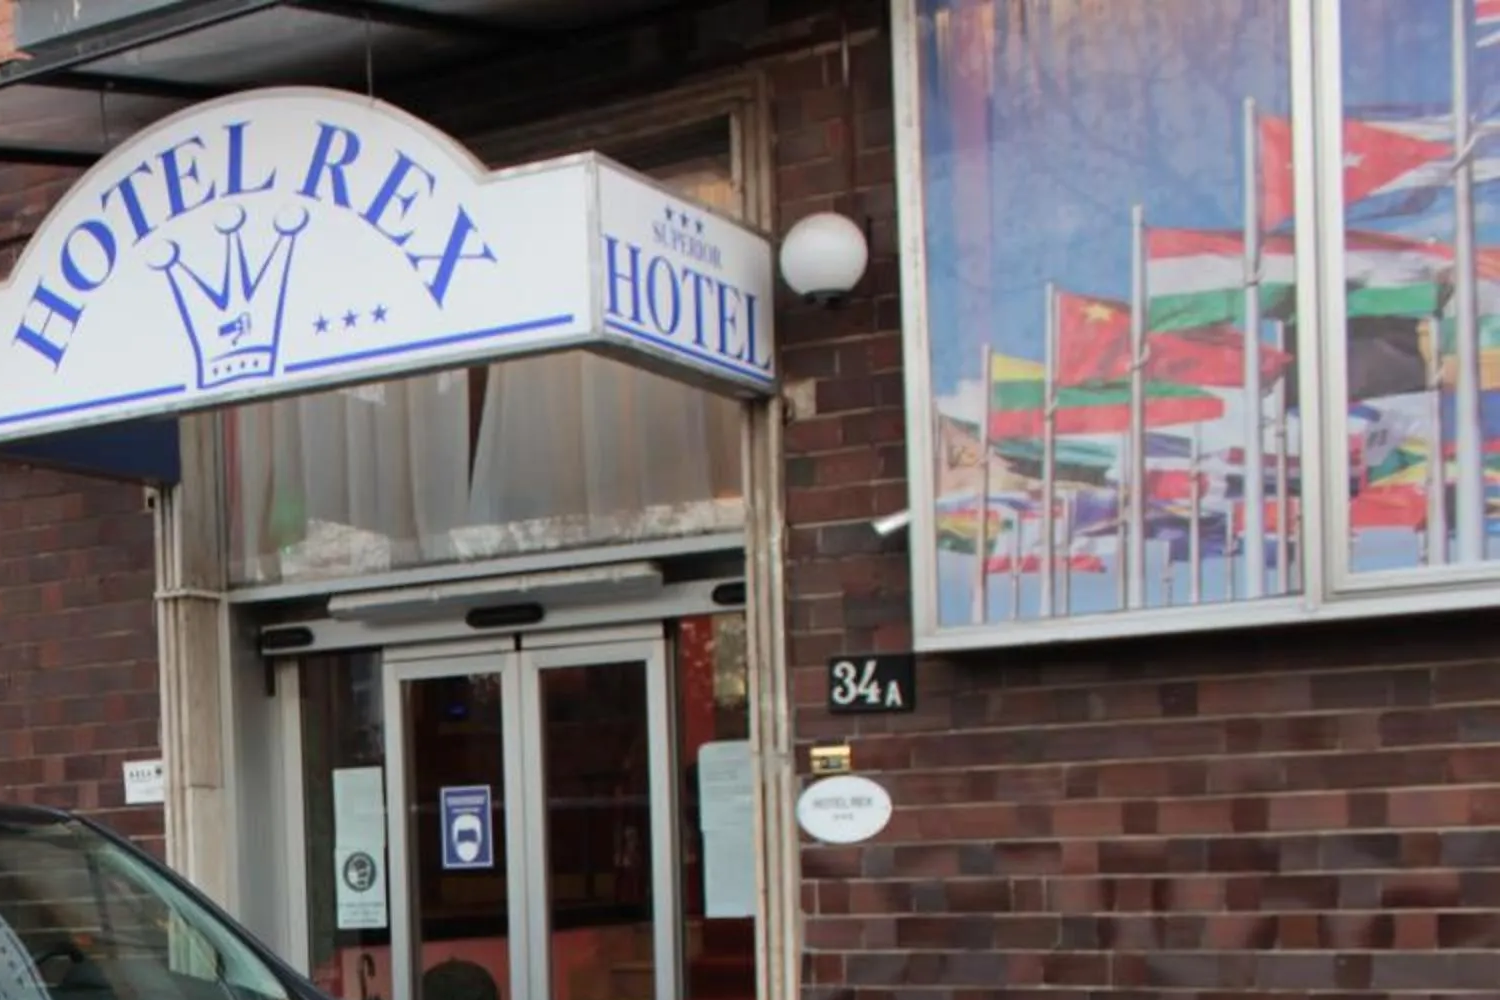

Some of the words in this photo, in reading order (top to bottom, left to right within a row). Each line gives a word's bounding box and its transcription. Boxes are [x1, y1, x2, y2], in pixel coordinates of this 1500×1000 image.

[14, 120, 276, 372] HOTEL
[296, 120, 498, 309] REX
[604, 233, 772, 371] HOTEL
